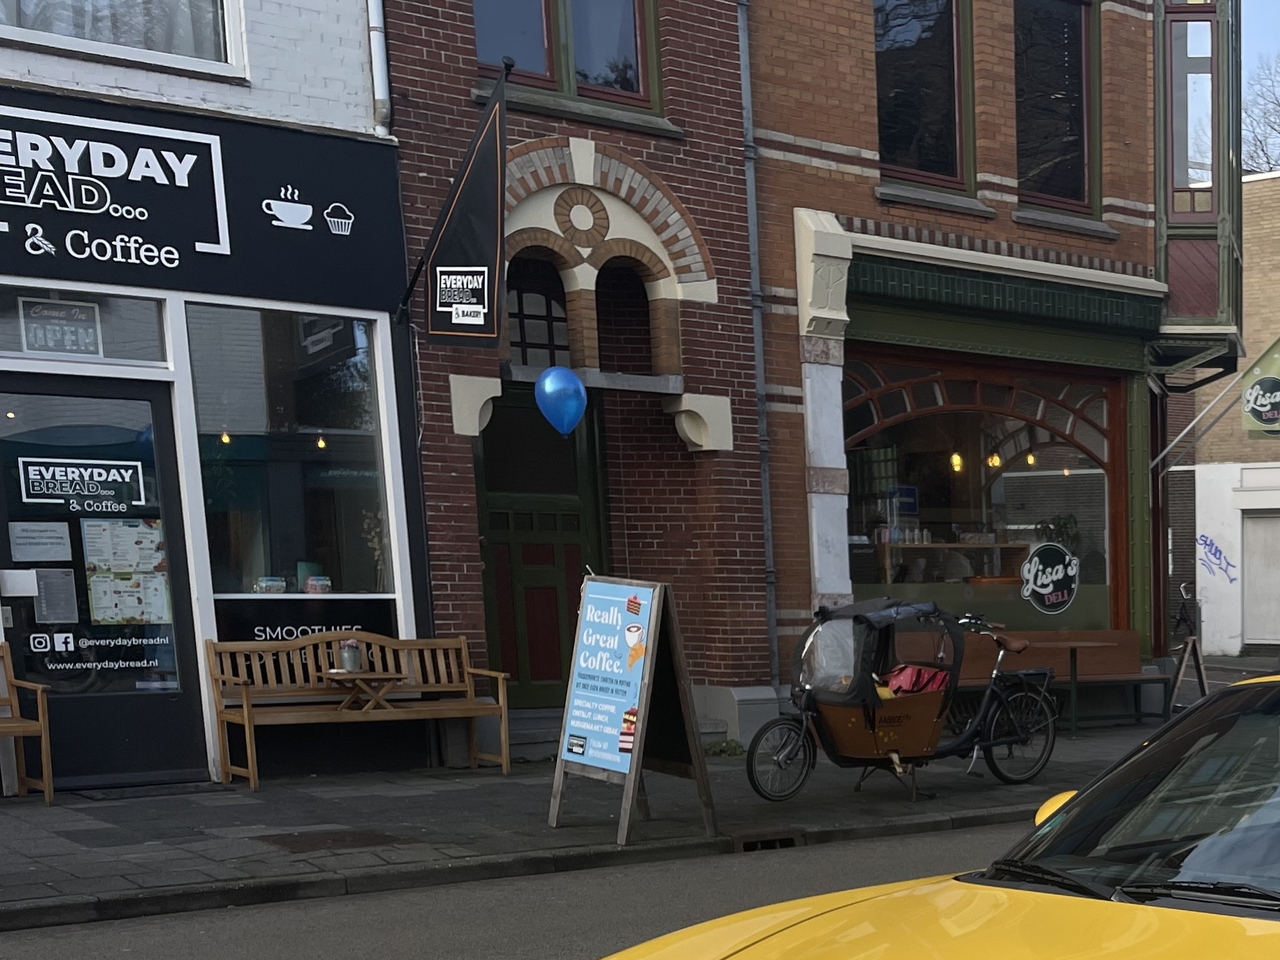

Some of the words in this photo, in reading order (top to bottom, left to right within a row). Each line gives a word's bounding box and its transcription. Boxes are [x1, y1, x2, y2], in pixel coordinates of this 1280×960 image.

[65, 230, 179, 268] Coffee
[440, 275, 484, 289] EVERYDAY
[30, 304, 66, 317] Come
[71, 308, 87, 320] In
[28, 323, 95, 351] OPEN
[28, 466, 133, 482] EVERYDAY
[69, 500, 81, 511] &
[84, 501, 127, 512] Coffee
[1022, 555, 1077, 597] Lisa's
[1044, 590, 1069, 606] DELI
[586, 604, 622, 630] Really
[79, 636, 169, 649] @everydaybreadnl
[583, 628, 619, 650] Great
[47, 659, 159, 671] www.everydaybread.nl
[580, 651, 623, 674] Coffee.
[574, 699, 598, 710] SPECIALTY
